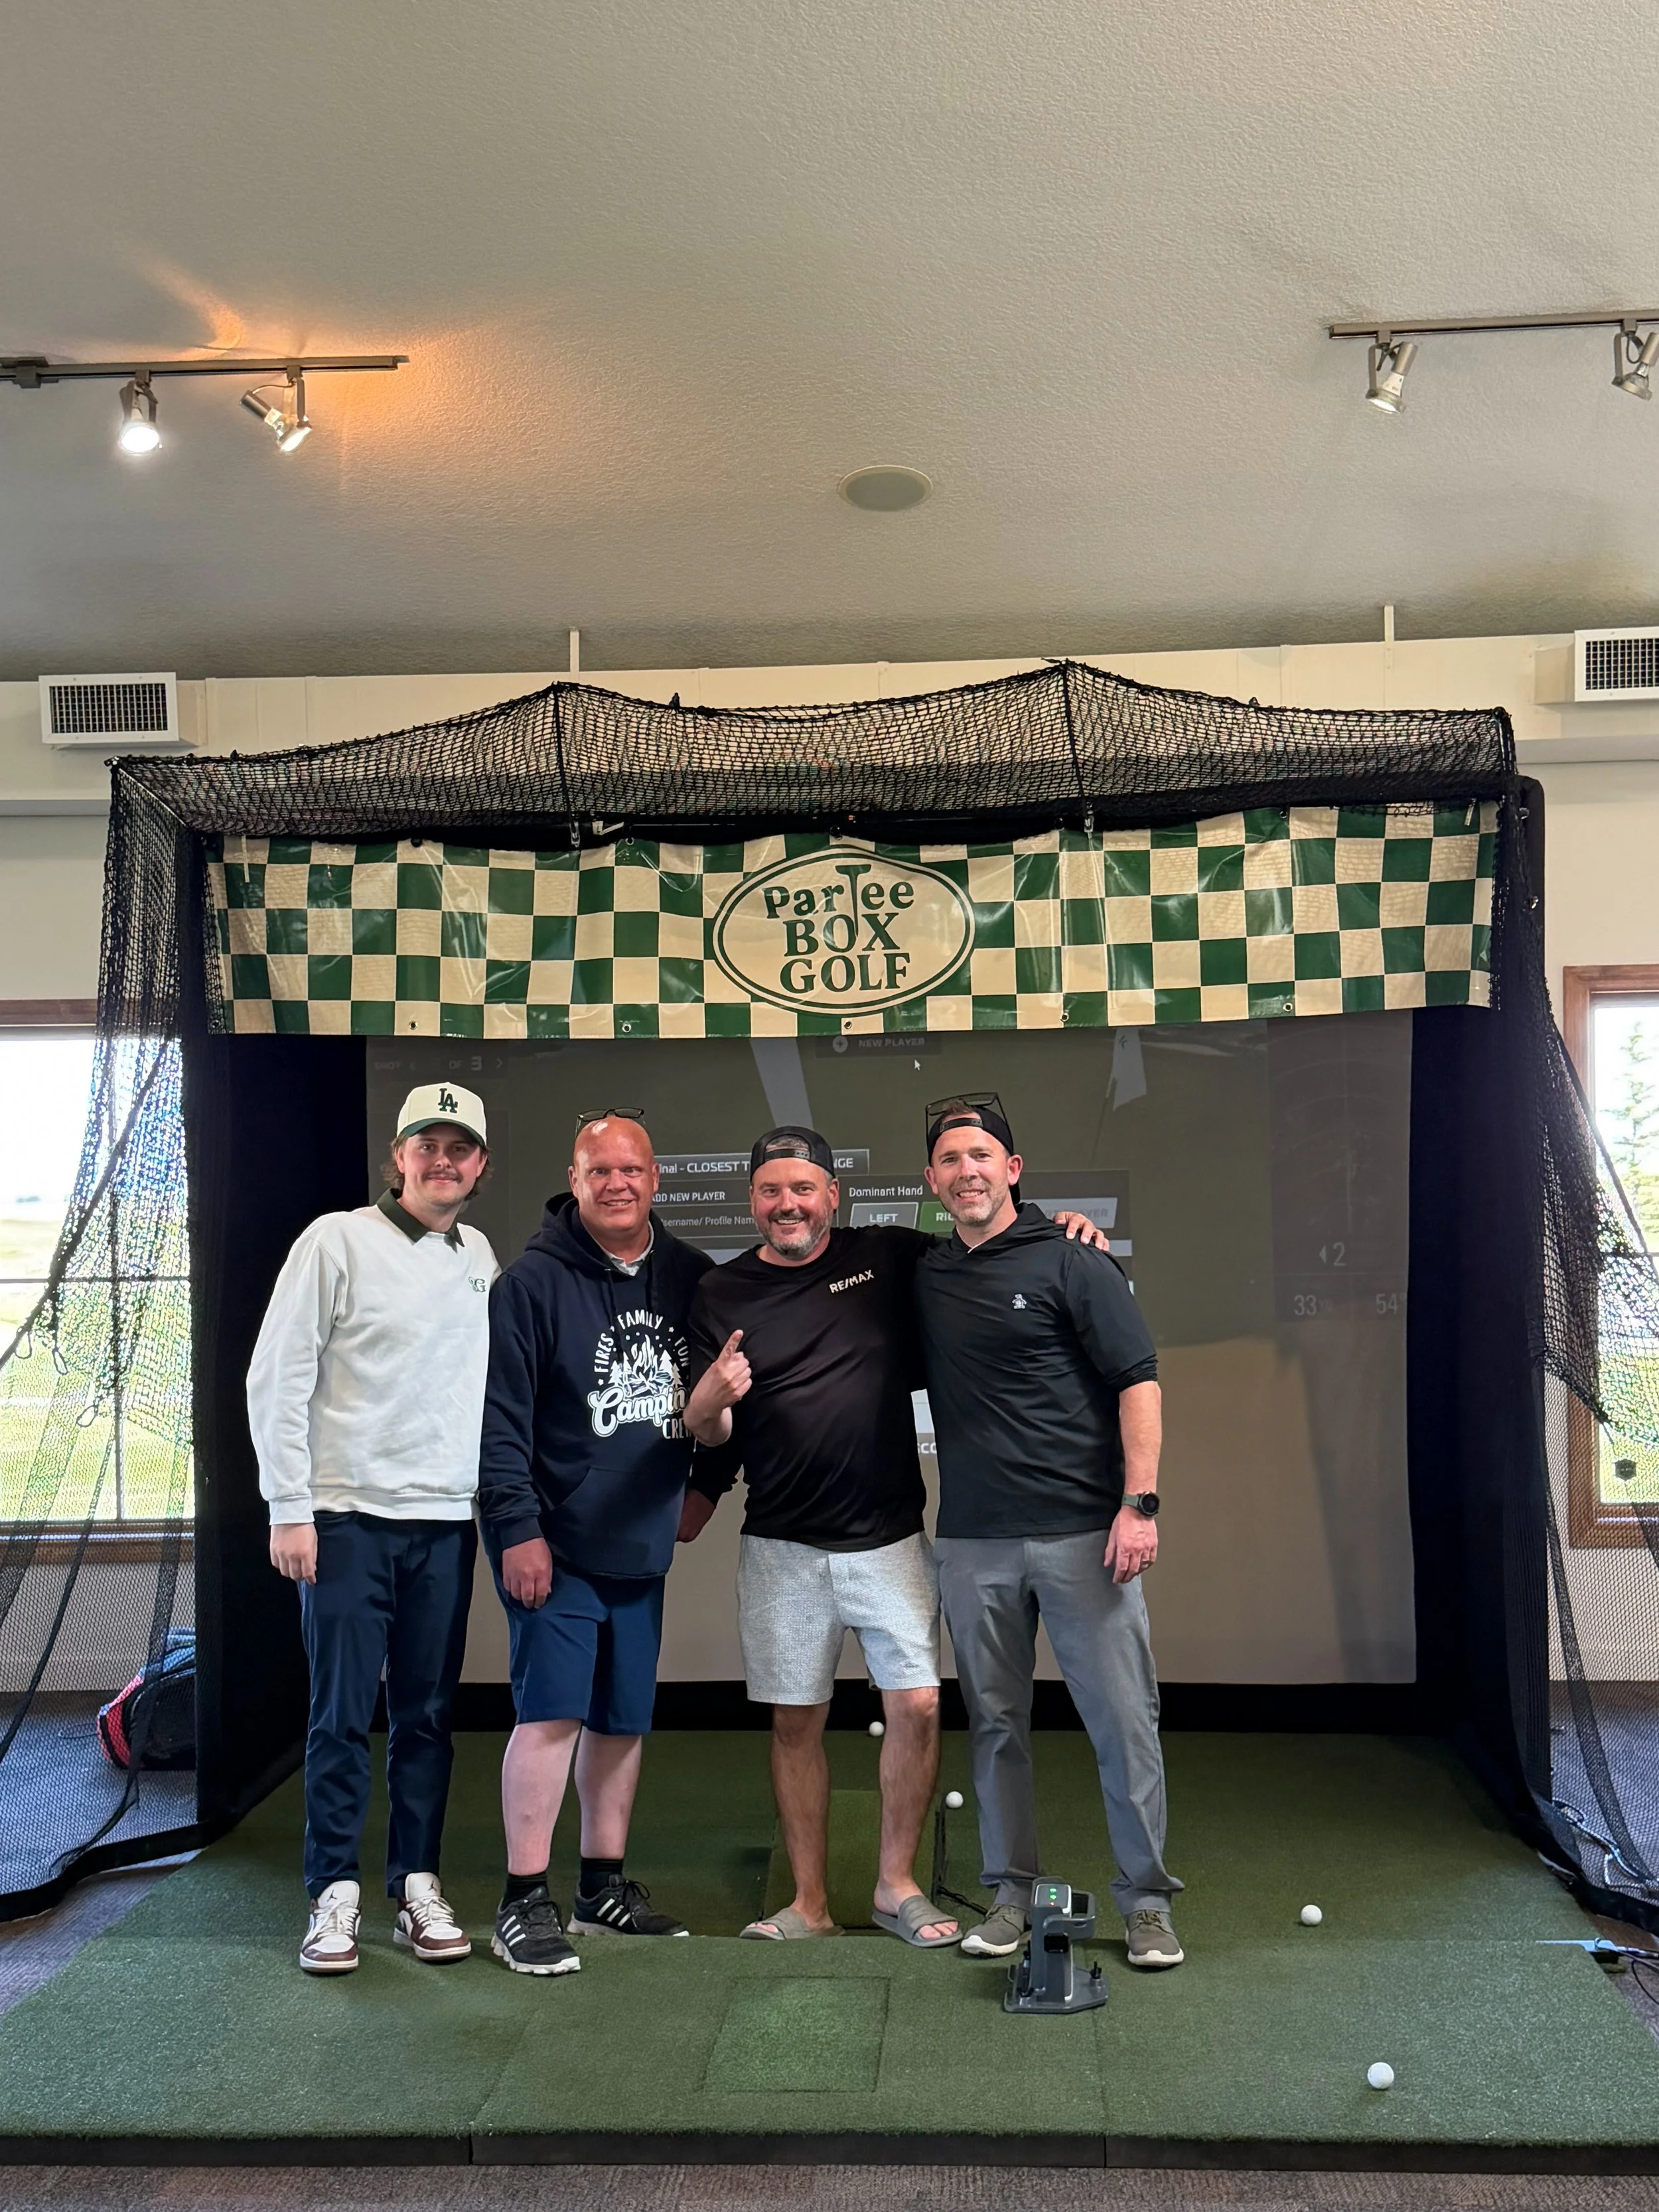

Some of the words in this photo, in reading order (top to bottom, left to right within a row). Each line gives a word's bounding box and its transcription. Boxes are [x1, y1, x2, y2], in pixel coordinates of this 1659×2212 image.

[783, 912, 900, 957] BOX
[780, 952, 910, 993] GOLF
[858, 1039, 883, 1048] NEW
[885, 1037, 925, 1047] PLAYER
[470, 1056, 482, 1071] 3
[437, 1087, 459, 1114] LA
[658, 1162, 678, 1174] inal
[687, 1161, 740, 1173] CLOSEST
[741, 1161, 750, 1172] T
[670, 1192, 690, 1202] NEW
[691, 1191, 726, 1201] PLAYER
[849, 1186, 895, 1197] Dominant
[897, 1185, 924, 1196] Hand
[661, 1217, 703, 1227] sername/
[705, 1215, 732, 1225] Profile
[734, 1215, 755, 1225] Nam
[869, 1213, 899, 1223] LEFT
[1332, 1241, 1346, 1267] 2
[829, 1269, 875, 1294] RE/MAX
[1293, 1294, 1317, 1316] 33
[593, 1332, 614, 1373] FIRES
[616, 1308, 664, 1330] FAMILY
[674, 1336, 690, 1367] FUN
[587, 1386, 687, 1438] Campin
